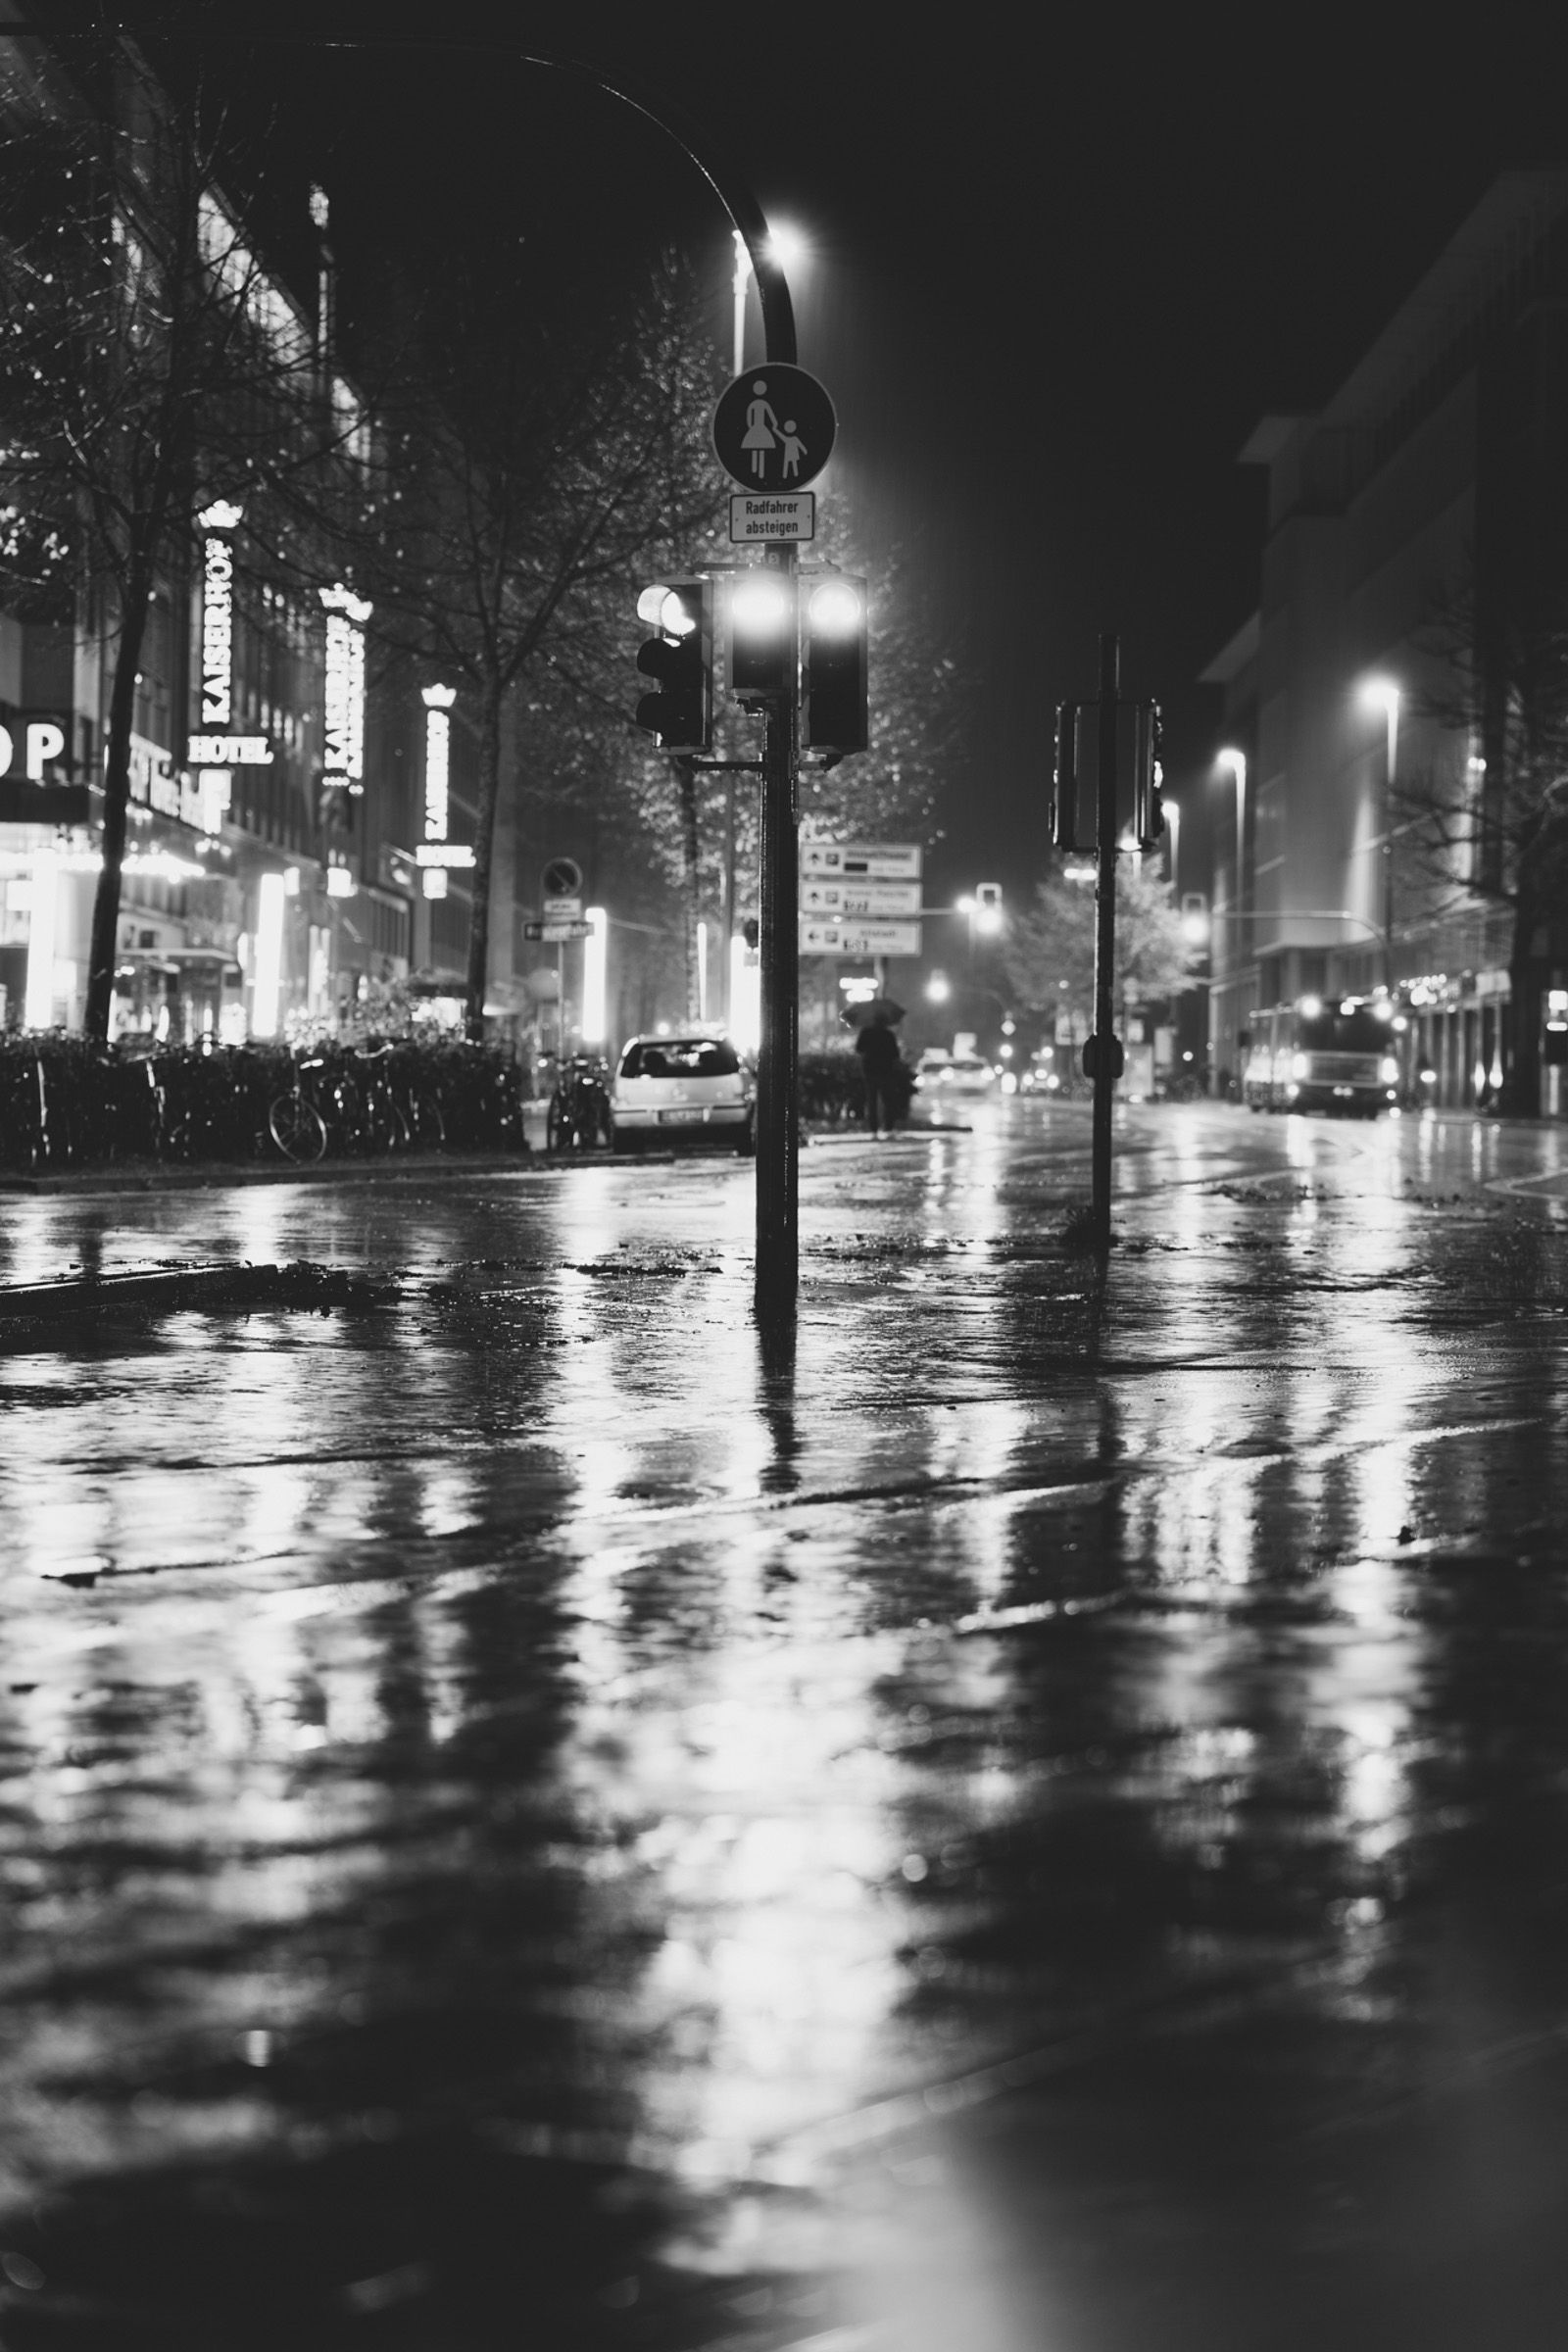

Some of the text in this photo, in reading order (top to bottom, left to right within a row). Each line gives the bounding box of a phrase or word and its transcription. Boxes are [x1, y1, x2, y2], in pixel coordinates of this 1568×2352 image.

[746, 500, 799, 514] Radfahrer
[746, 520, 799, 536] absteigen
[203, 538, 233, 723] KAISERHOF
[188, 736, 274, 763] HOTEL
